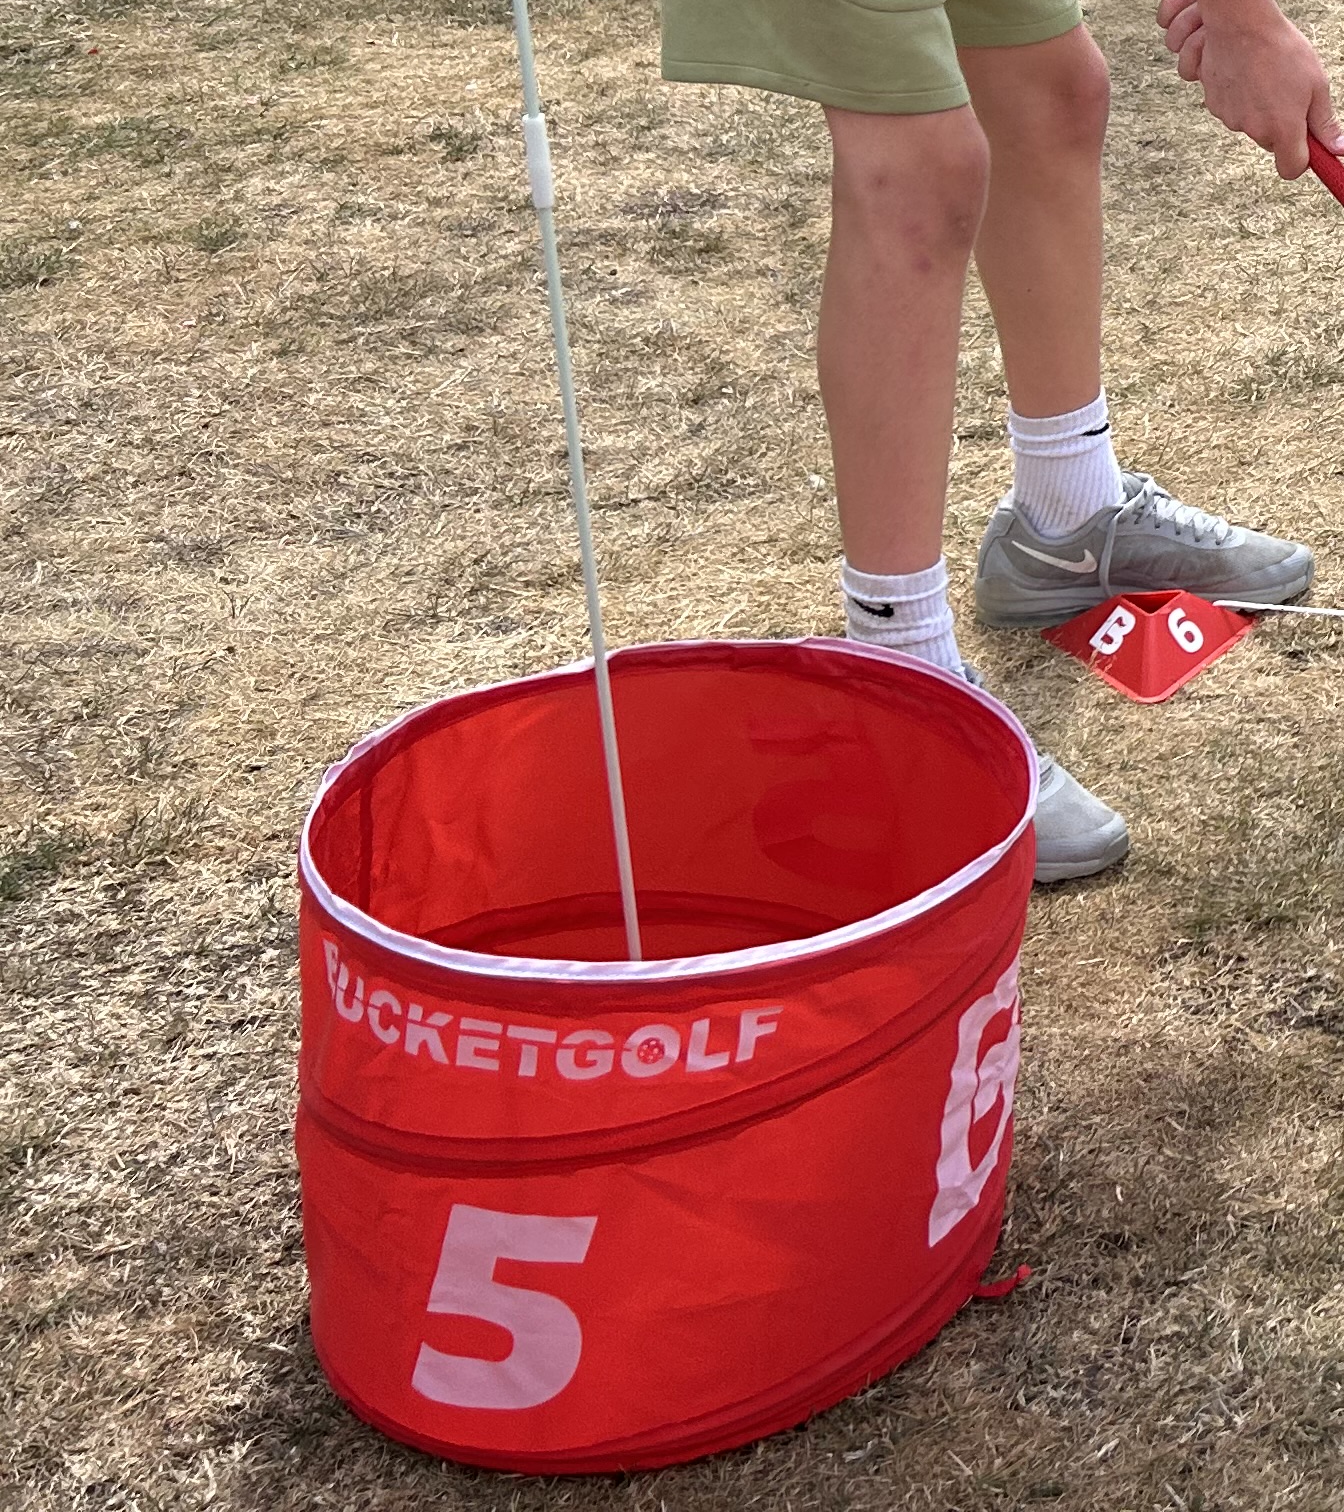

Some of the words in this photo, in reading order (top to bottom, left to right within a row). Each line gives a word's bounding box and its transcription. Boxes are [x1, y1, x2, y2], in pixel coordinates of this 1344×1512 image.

[1088, 604, 1137, 655] B
[1167, 607, 1204, 653] 6
[411, 1203, 598, 1410] 5
